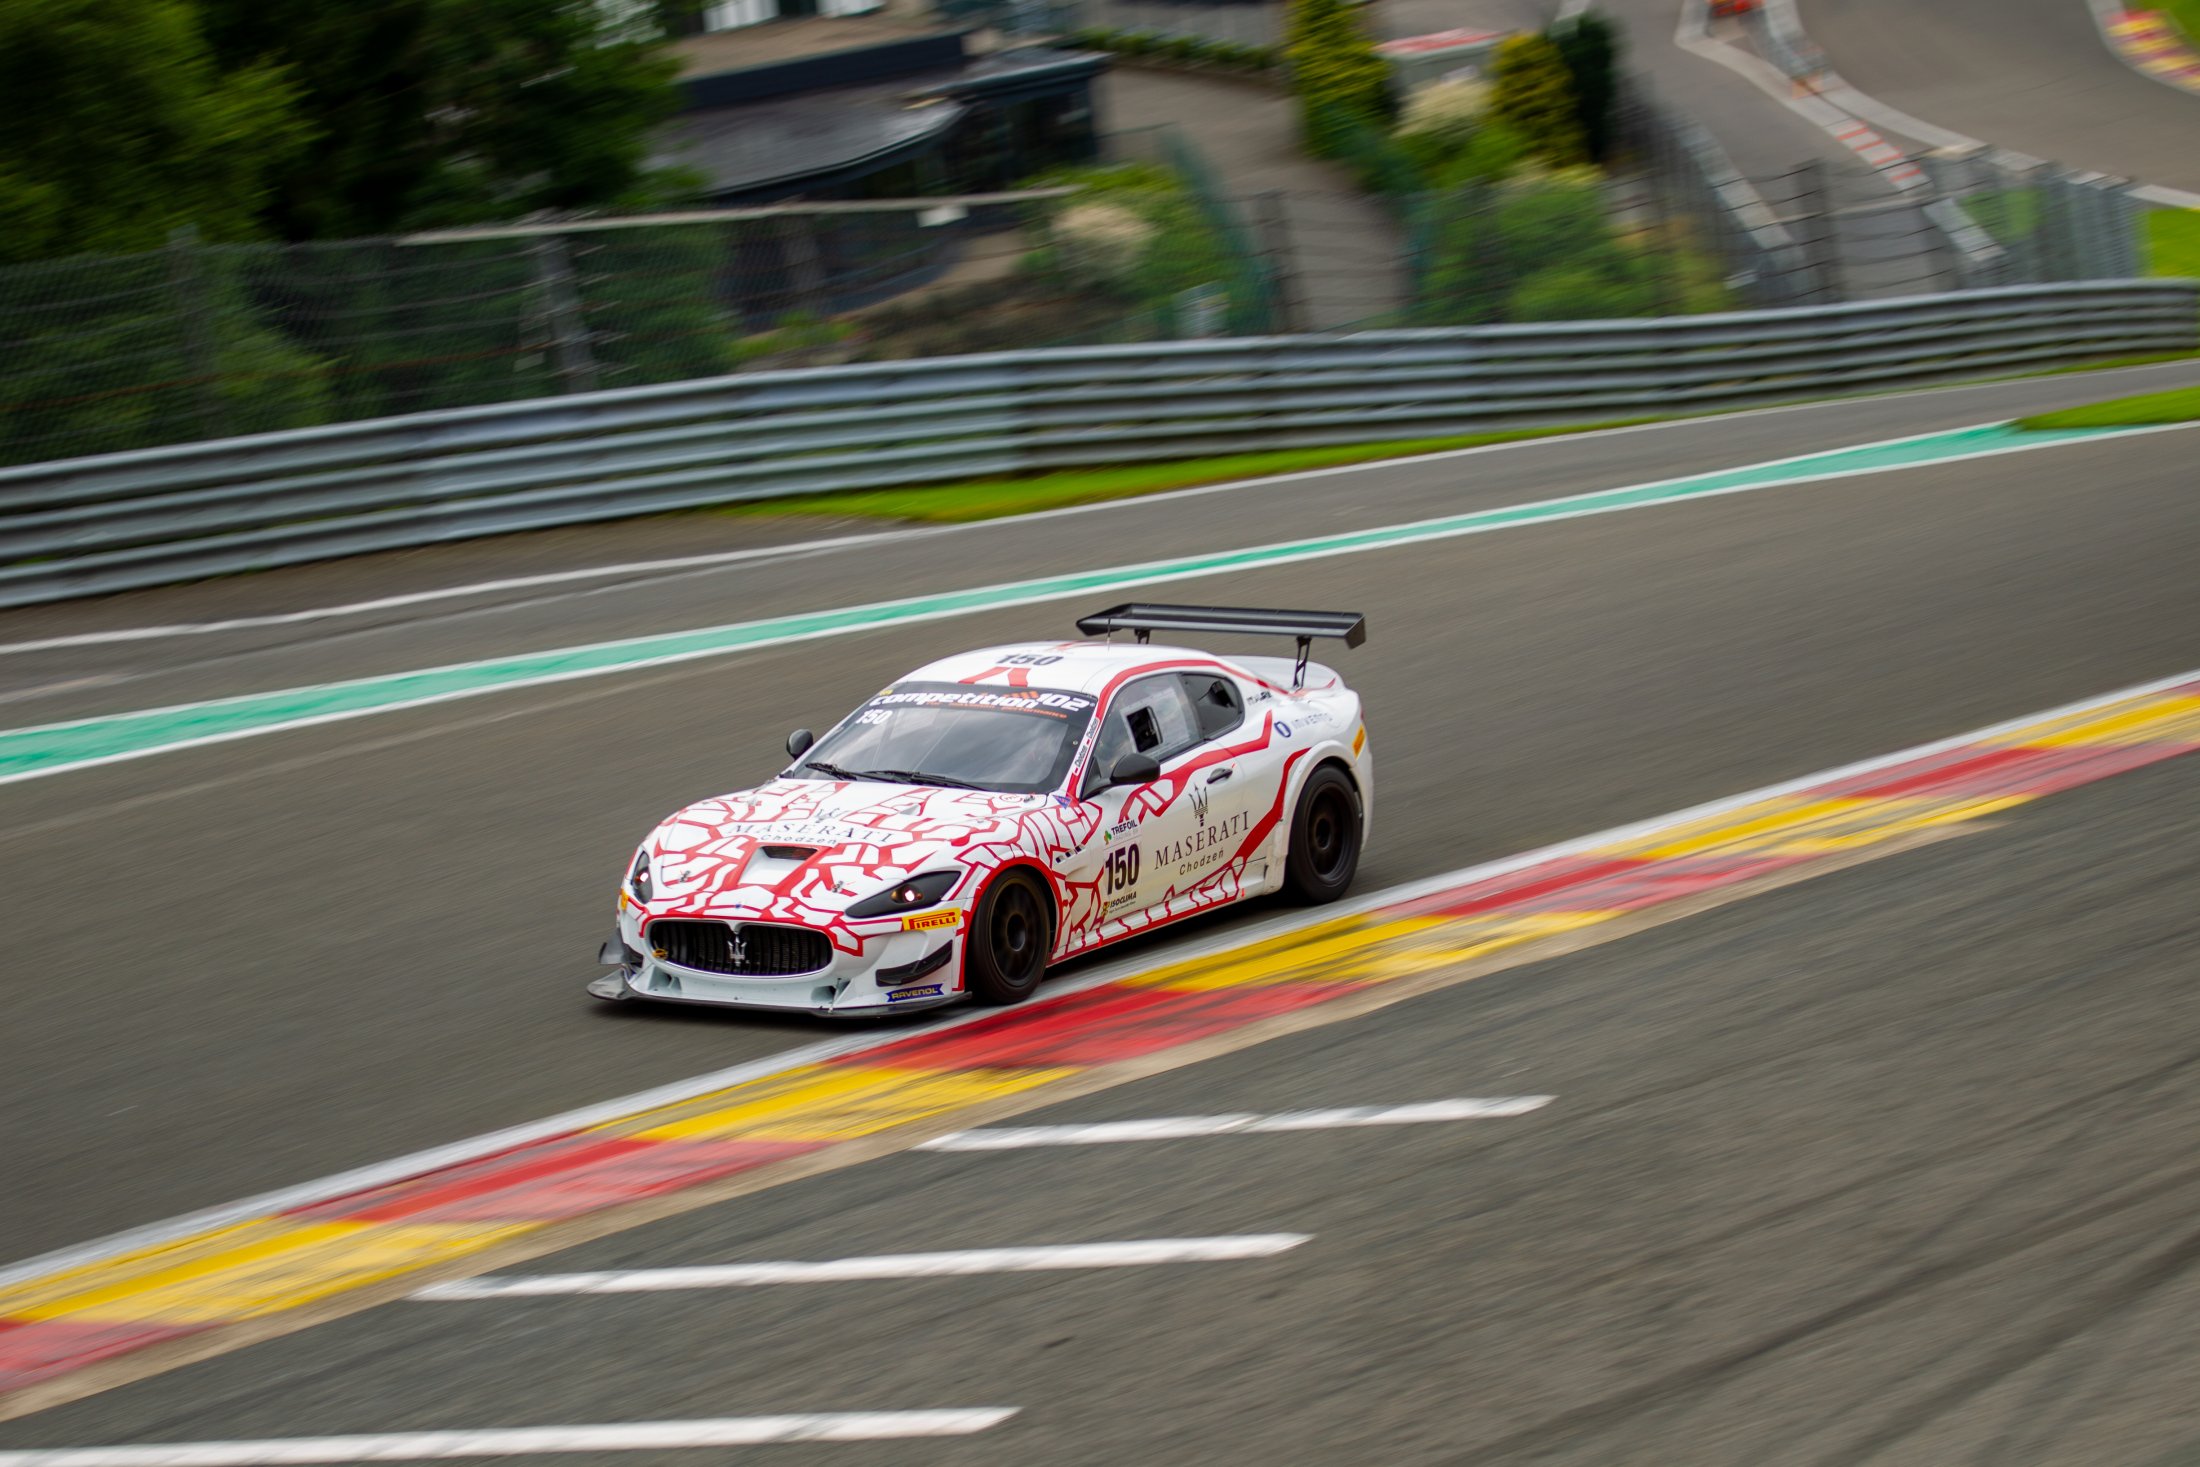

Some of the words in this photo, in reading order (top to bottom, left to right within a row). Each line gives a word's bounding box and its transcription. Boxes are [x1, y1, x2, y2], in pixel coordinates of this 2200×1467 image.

[996, 654, 1064, 666] 150
[855, 708, 894, 724] 150
[729, 823, 895, 843] MASERATI
[1110, 819, 1139, 836] TREFOIL
[1154, 811, 1250, 871] MASERATI
[1104, 843, 1141, 896] 150
[908, 912, 957, 930] PIRELLI
[891, 987, 939, 1000] RAVENOL
